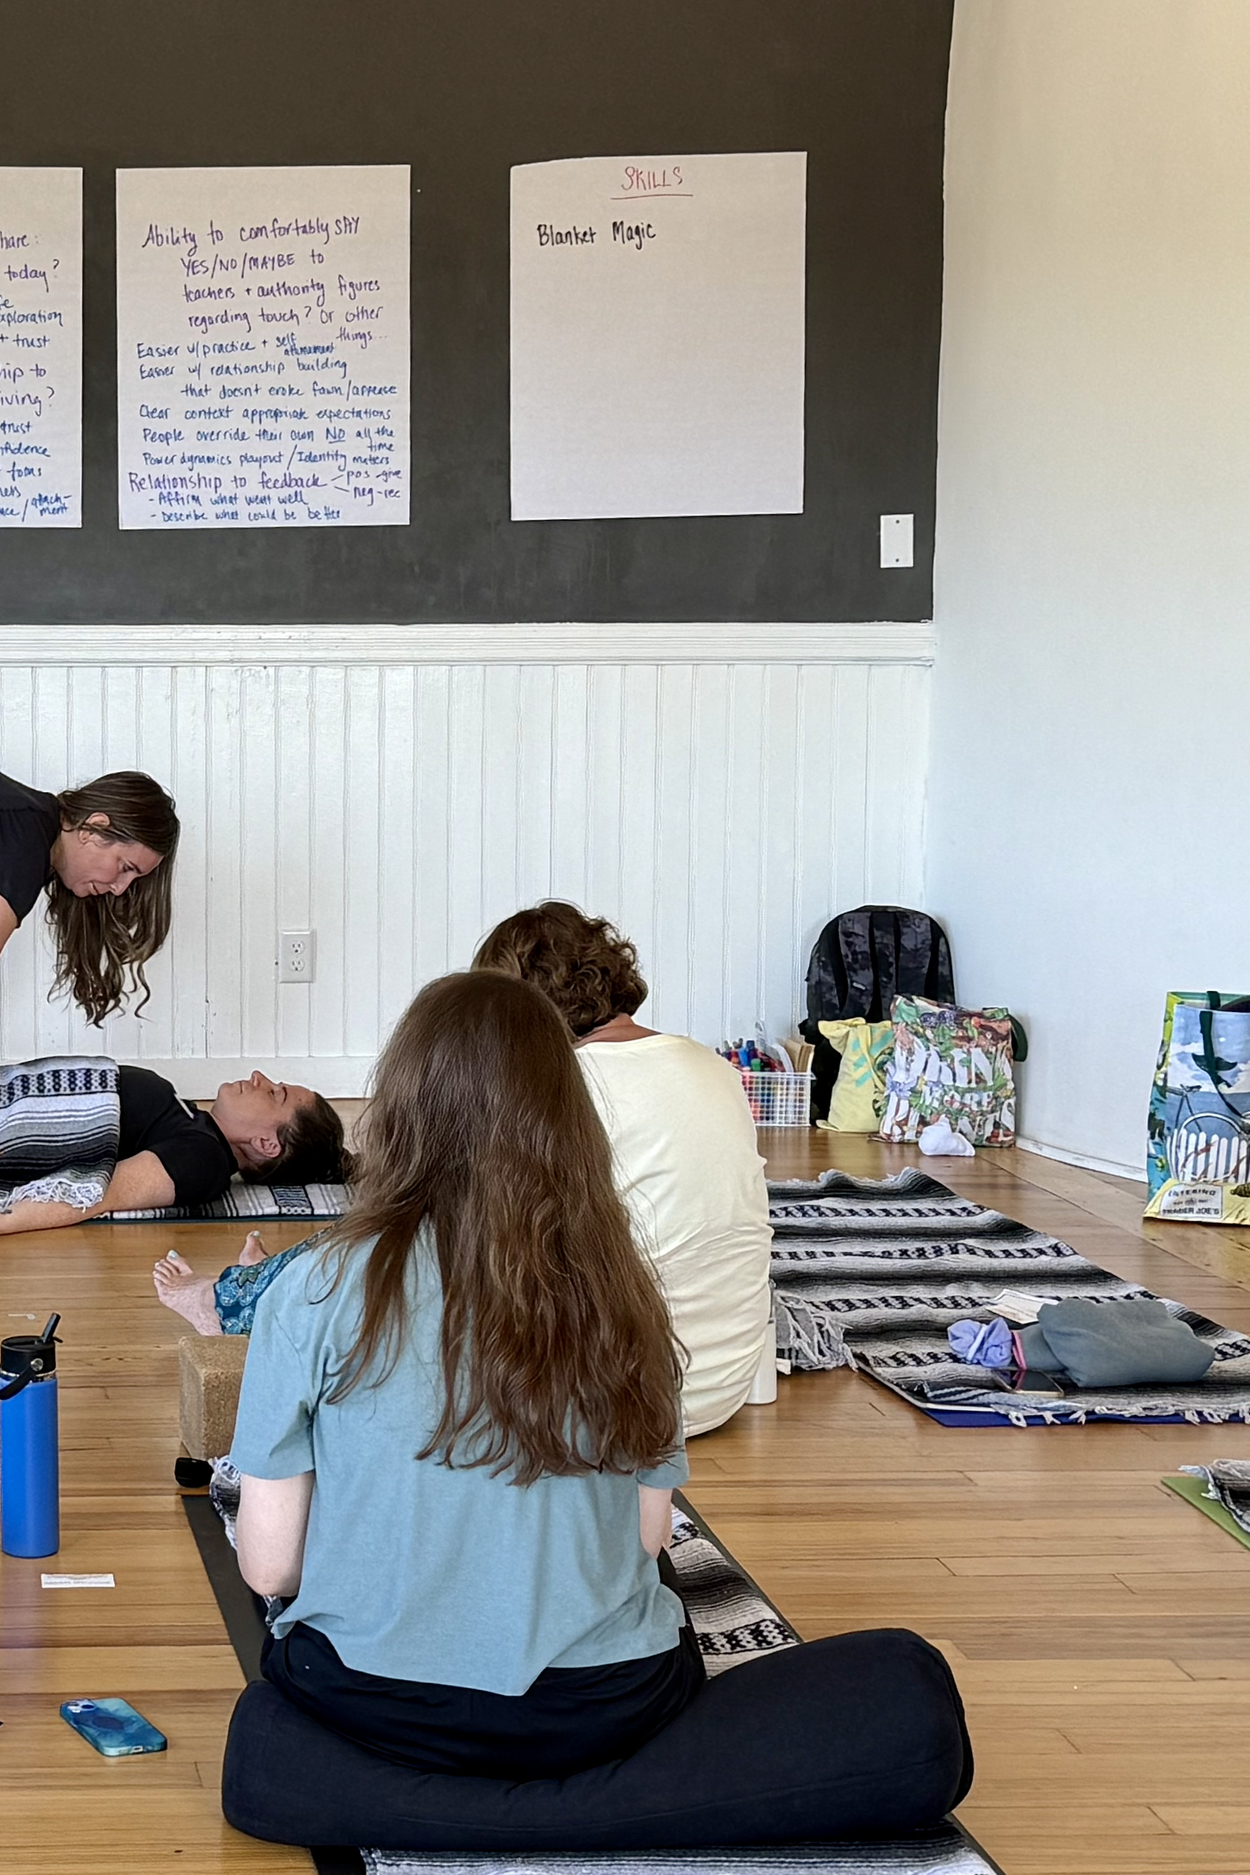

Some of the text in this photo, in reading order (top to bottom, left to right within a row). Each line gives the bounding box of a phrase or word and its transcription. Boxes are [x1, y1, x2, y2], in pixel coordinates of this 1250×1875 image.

[621, 165, 684, 191] SKILLS
[142, 215, 360, 256] Ability to comfortably SAY
[537, 220, 657, 250] Blanket Magic
[309, 248, 325, 265] to
[4, 258, 60, 293] today?
[183, 283, 236, 303] teachers
[257, 280, 325, 307] authority
[337, 273, 380, 300] figures
[188, 308, 252, 334] regarding
[345, 305, 384, 323] other
[12, 335, 50, 350] trust
[137, 342, 180, 359] Easier
[275, 332, 298, 348] self
[29, 363, 47, 378] to
[139, 362, 175, 380] Easier
[210, 360, 285, 375] relationship
[296, 357, 348, 379] building
[180, 383, 212, 397] that
[184, 405, 234, 420] context
[142, 428, 185, 446] People
[196, 427, 250, 441] override
[255, 428, 283, 441] their
[355, 426, 373, 443] all
[375, 425, 395, 438] the
[367, 441, 395, 452] time
[142, 452, 177, 466] Power
[180, 451, 232, 472] dynamics
[128, 471, 223, 494] Relationship
[230, 475, 247, 489] to
[258, 470, 328, 490] feedback
[210, 493, 238, 506] what
[277, 490, 309, 505] well
[215, 509, 239, 520] what
[248, 508, 277, 522] could
[285, 506, 298, 520] be
